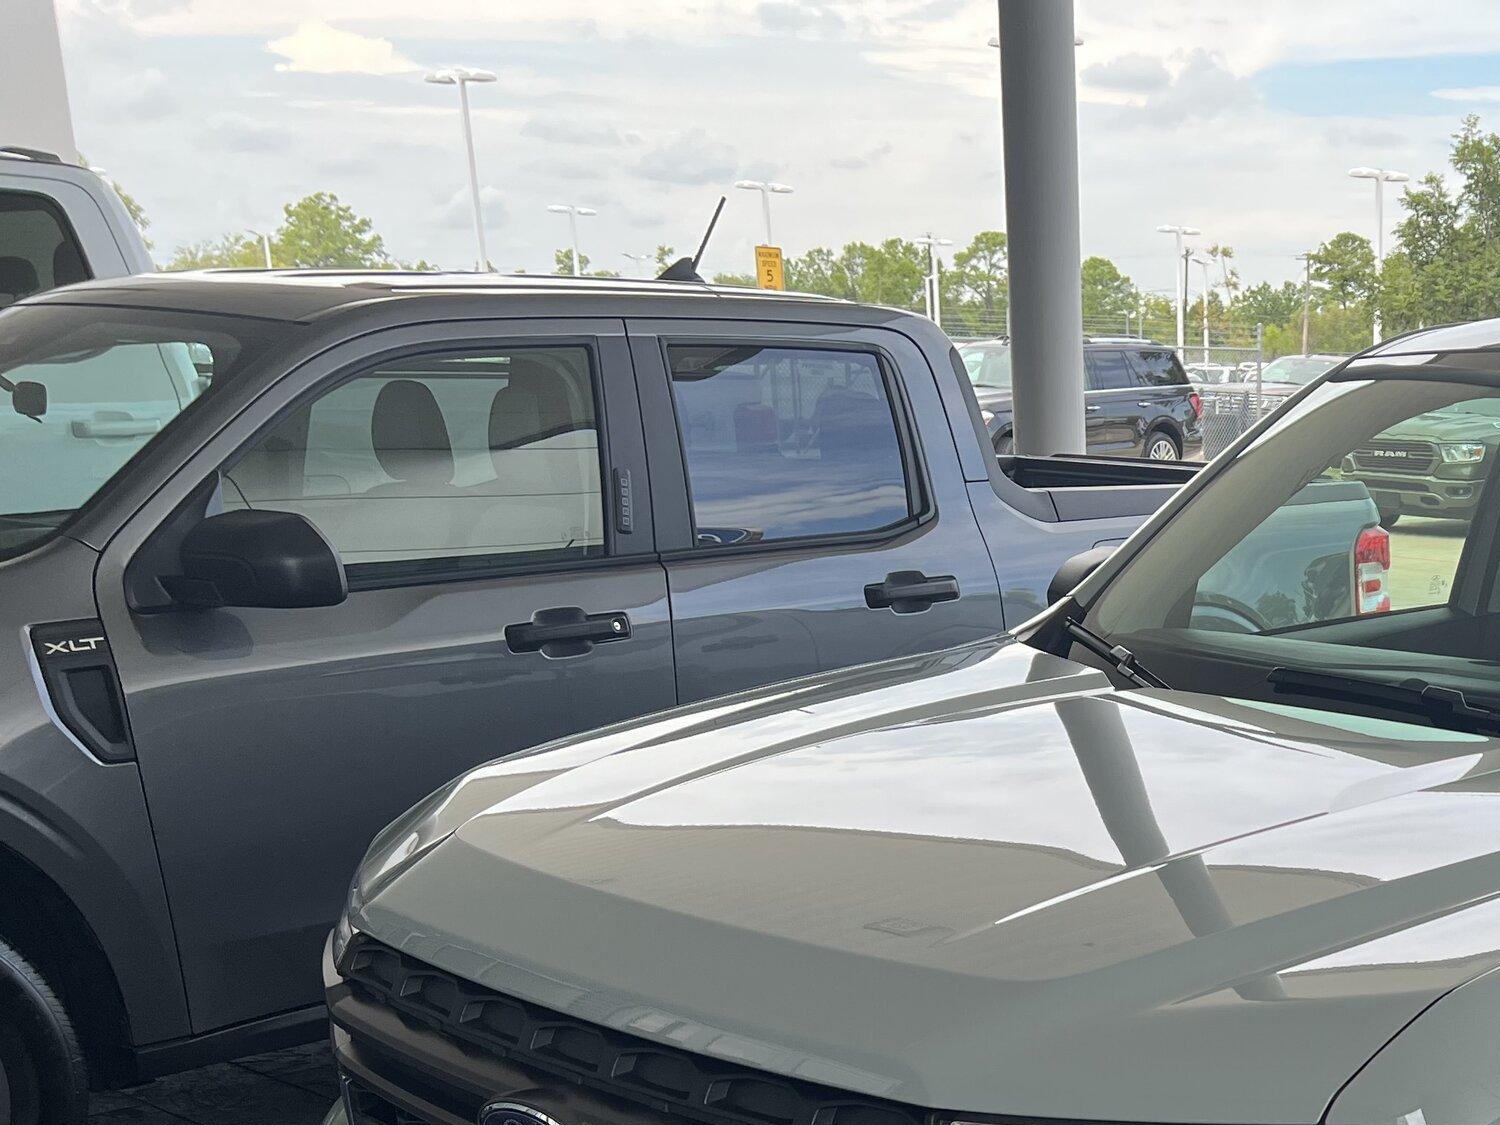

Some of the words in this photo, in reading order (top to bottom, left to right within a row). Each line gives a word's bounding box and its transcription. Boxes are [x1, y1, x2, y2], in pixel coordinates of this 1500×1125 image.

[766, 269, 774, 282] 5
[1374, 450, 1407, 458] RAM
[44, 636, 104, 655] XLT
